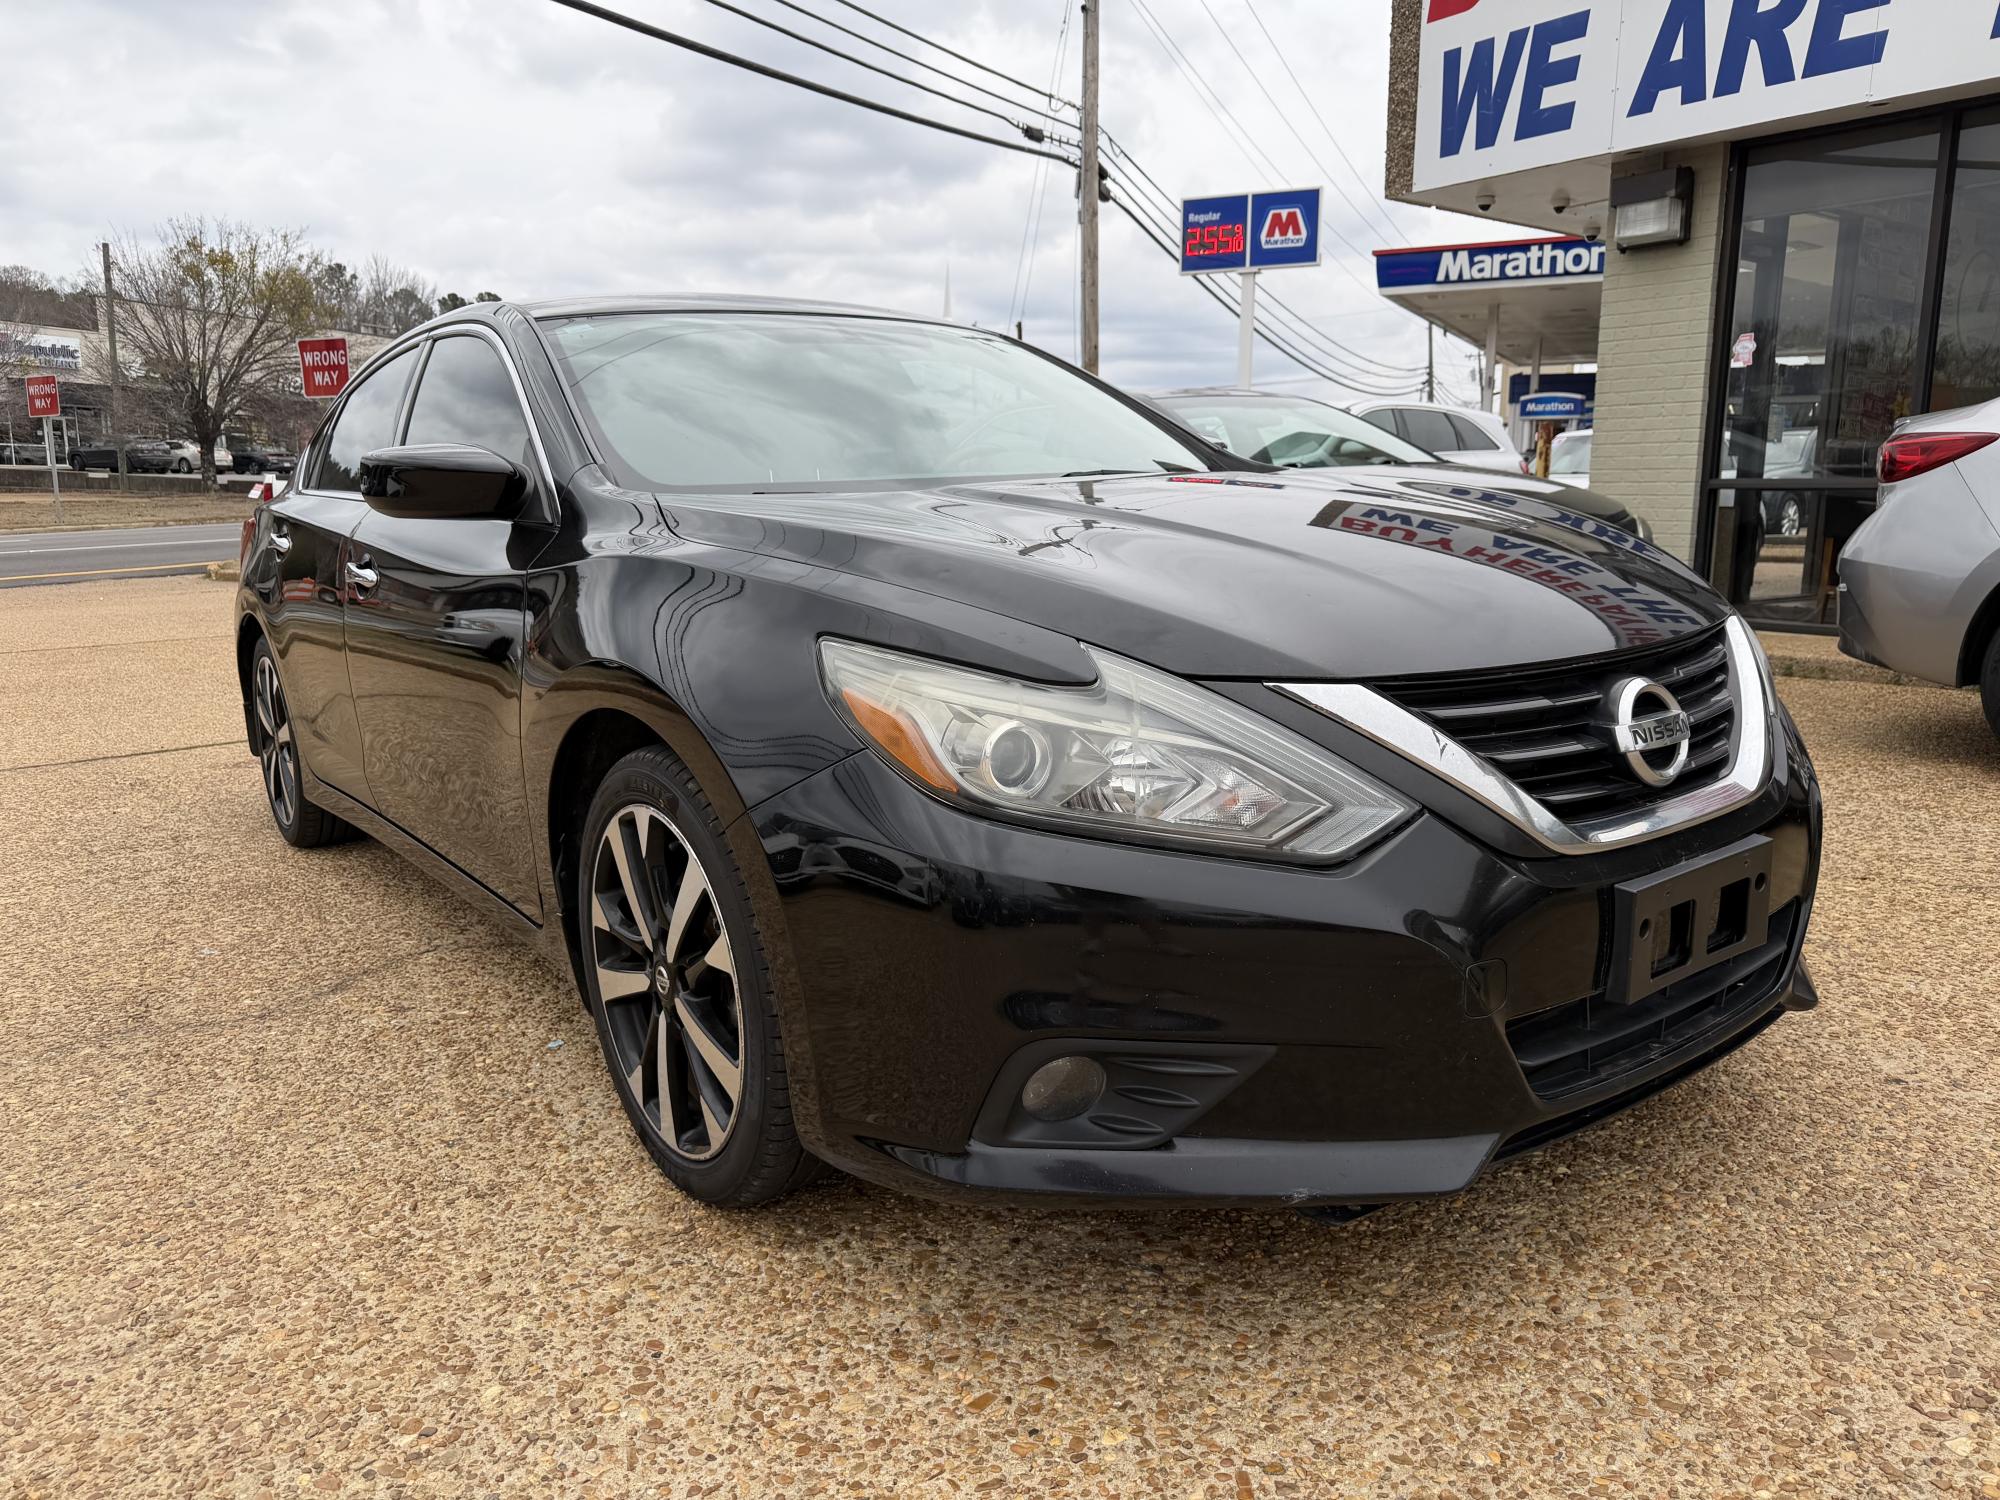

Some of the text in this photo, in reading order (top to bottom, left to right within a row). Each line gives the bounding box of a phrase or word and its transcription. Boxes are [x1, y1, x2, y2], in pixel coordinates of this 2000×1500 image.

[1440, 0, 1891, 158] WE ARE
[1188, 211, 1221, 224] Regular
[1263, 236, 1304, 247] Marathon
[303, 350, 346, 366] WRONG
[313, 370, 339, 386] WAY
[28, 383, 56, 396] WRONG
[34, 398, 52, 409] WAY
[1525, 401, 1575, 412] Marathon
[1630, 717, 1690, 745] NISSAN
